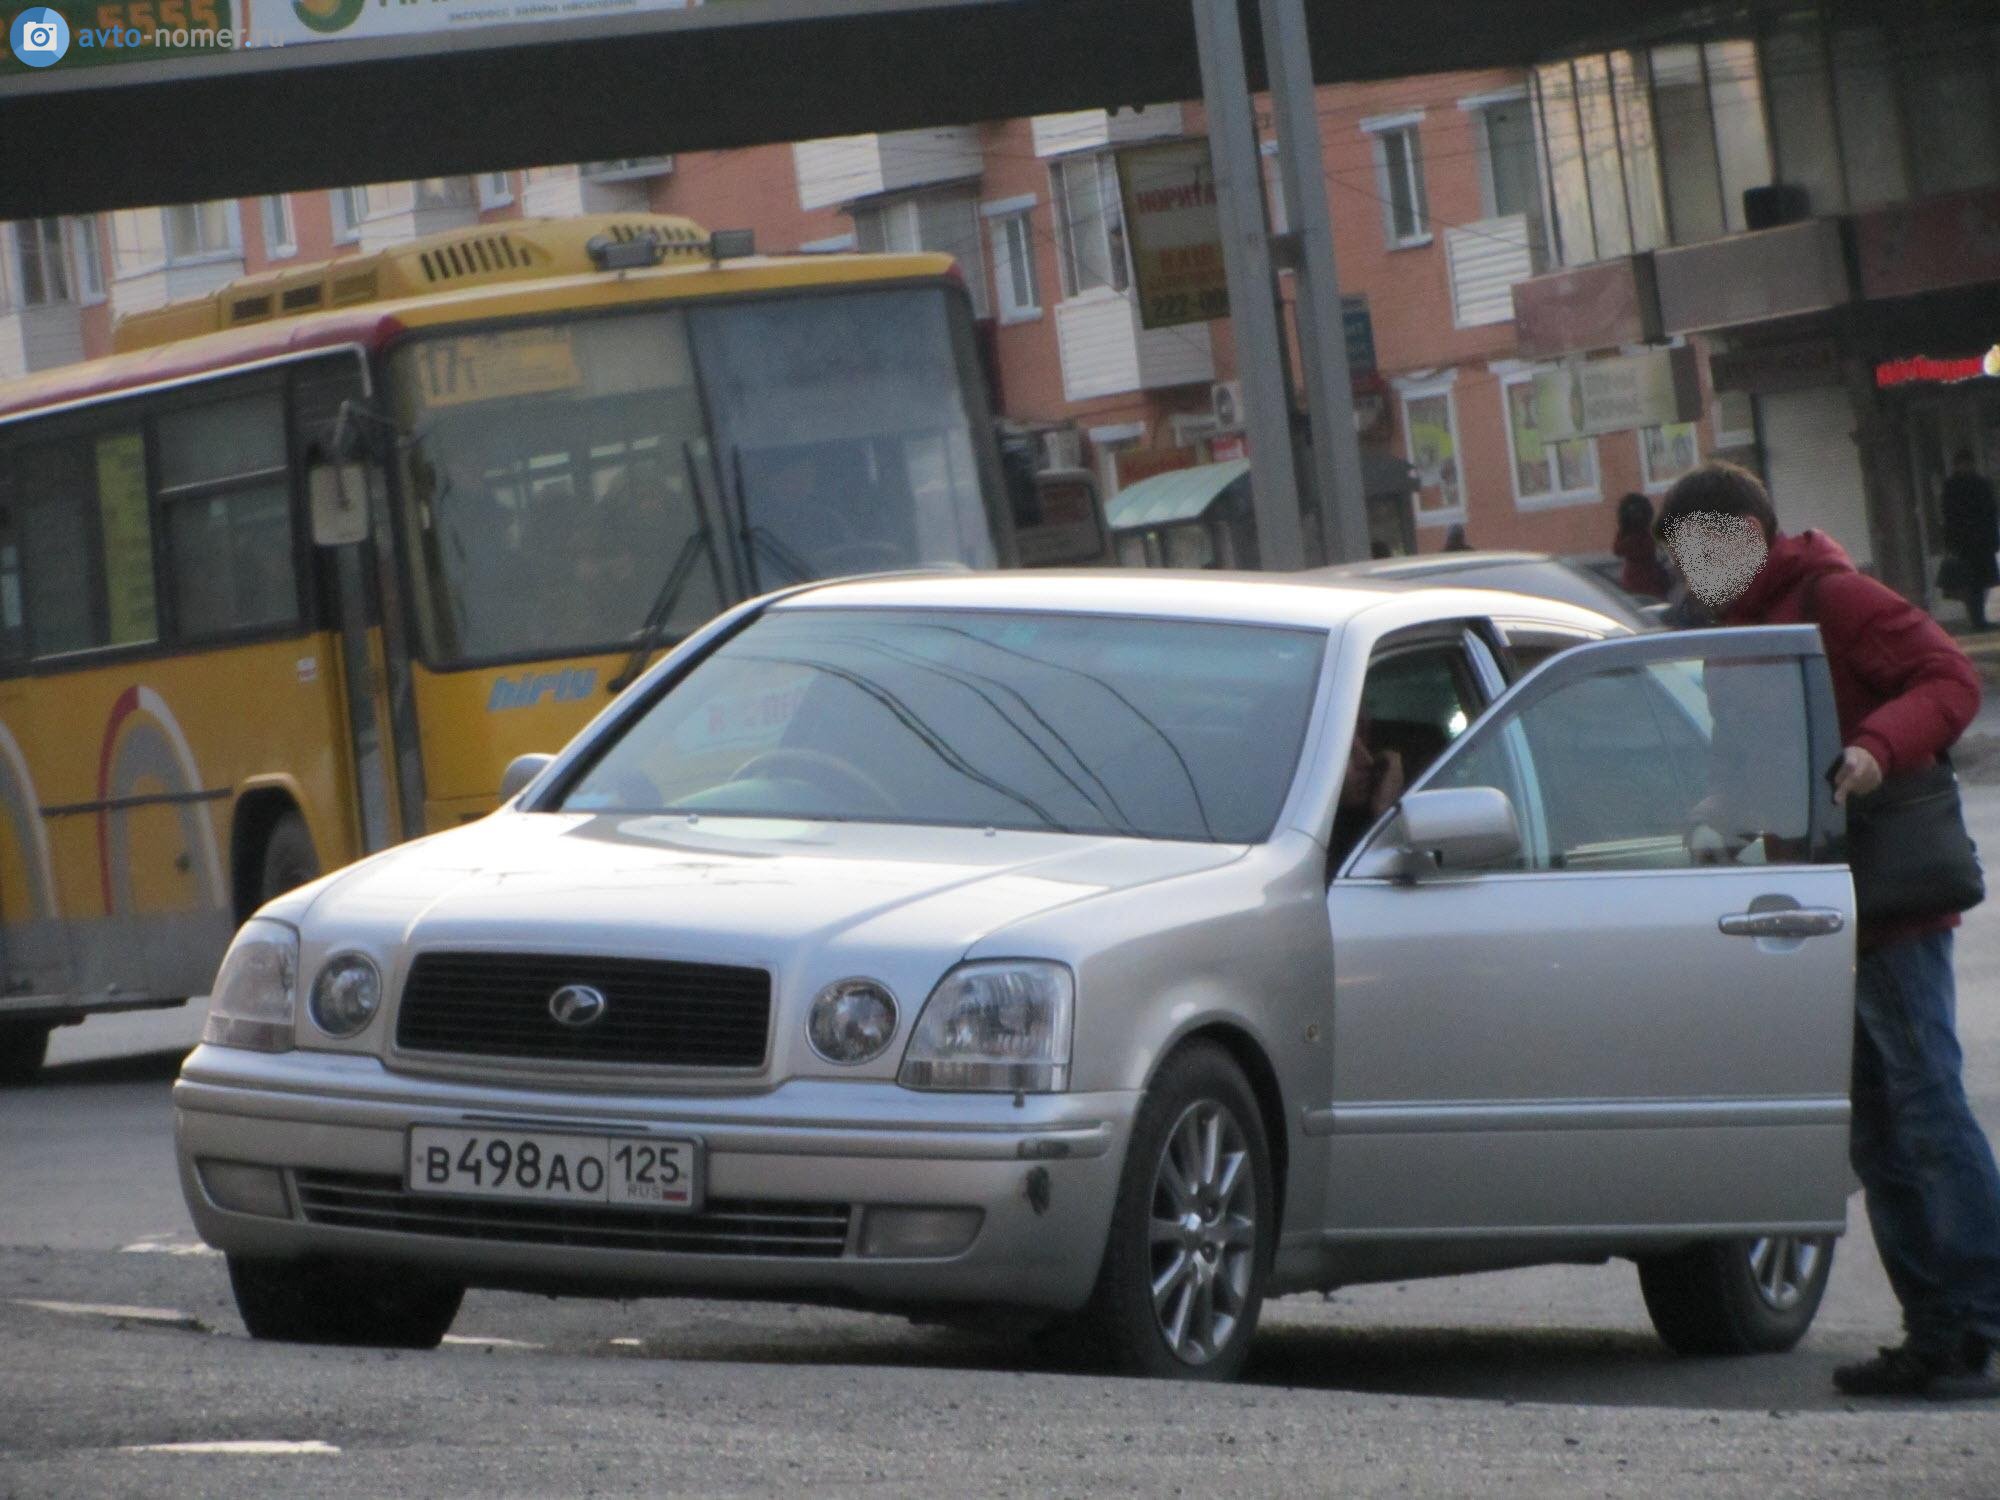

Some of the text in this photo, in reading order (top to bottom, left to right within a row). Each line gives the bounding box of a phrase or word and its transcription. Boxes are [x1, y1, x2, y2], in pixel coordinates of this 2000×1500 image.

[426, 1137, 605, 1193] В498АО
[615, 1145, 680, 1184] 125
[627, 1184, 661, 1200] RUS
